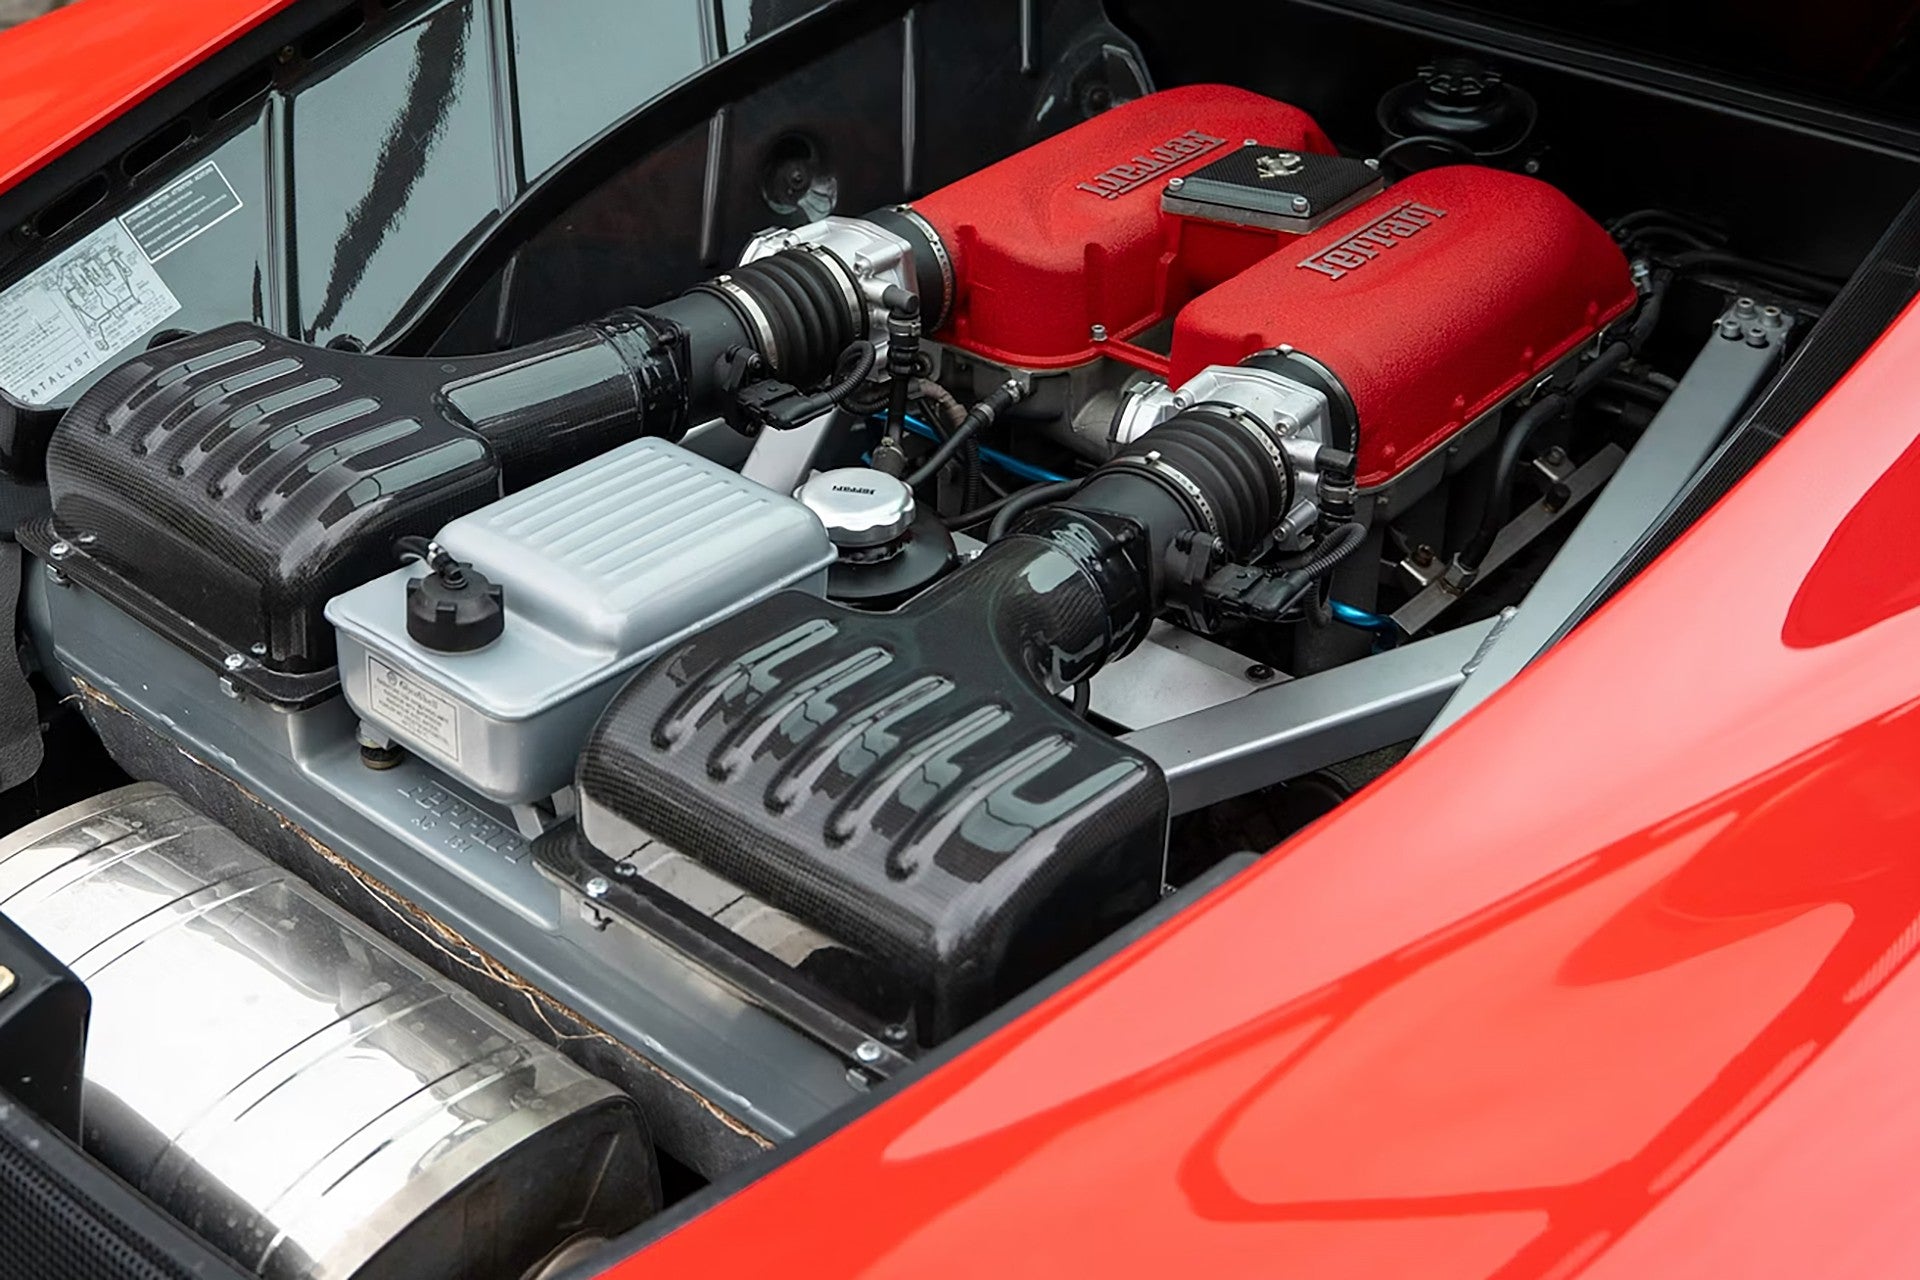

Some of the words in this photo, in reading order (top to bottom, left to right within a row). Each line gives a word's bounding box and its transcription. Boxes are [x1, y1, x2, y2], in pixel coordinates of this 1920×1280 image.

[1075, 129, 1228, 200] Ferrari
[1296, 200, 1448, 281] Ferrari
[21, 351, 91, 403] CATALYST
[832, 485, 876, 496] Ferrari
